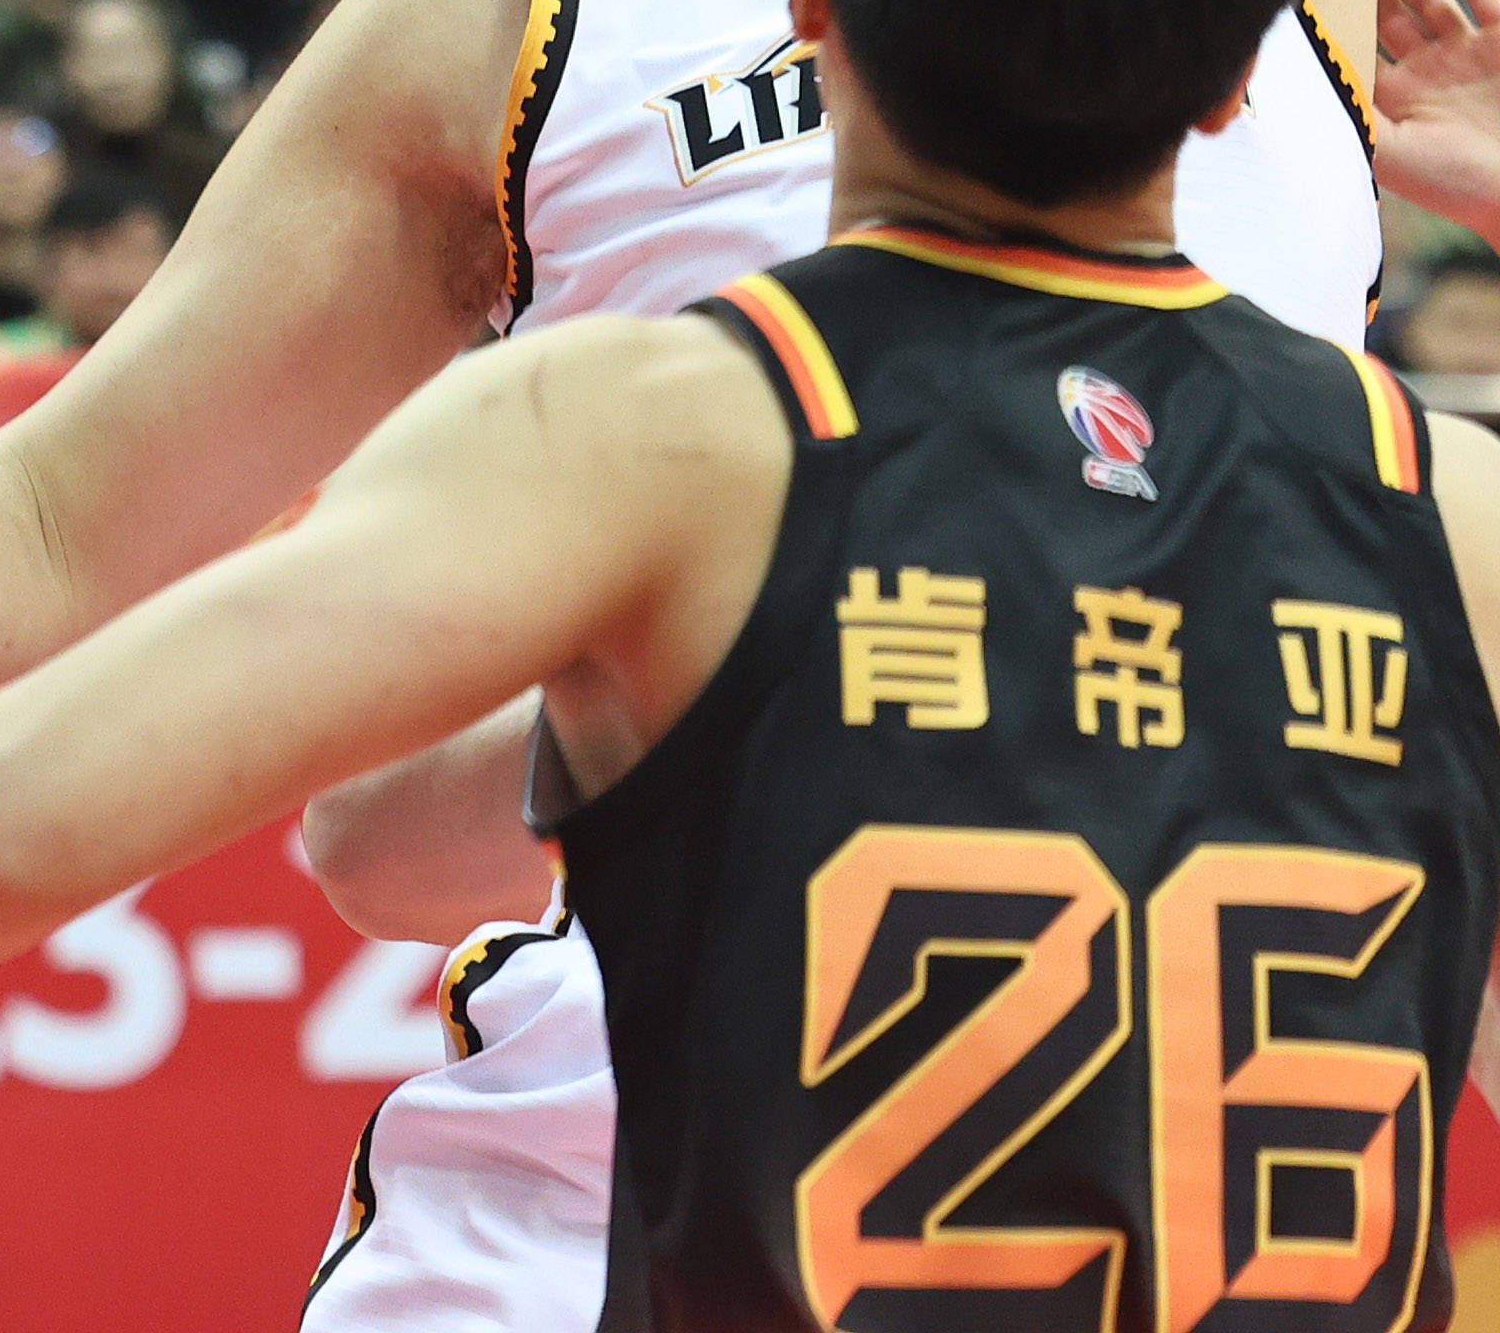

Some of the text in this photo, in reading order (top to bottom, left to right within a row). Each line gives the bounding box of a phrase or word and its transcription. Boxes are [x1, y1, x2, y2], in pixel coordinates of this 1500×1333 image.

[833, 565, 1409, 766] 肯帝亚
[795, 823, 1434, 1333] 26
